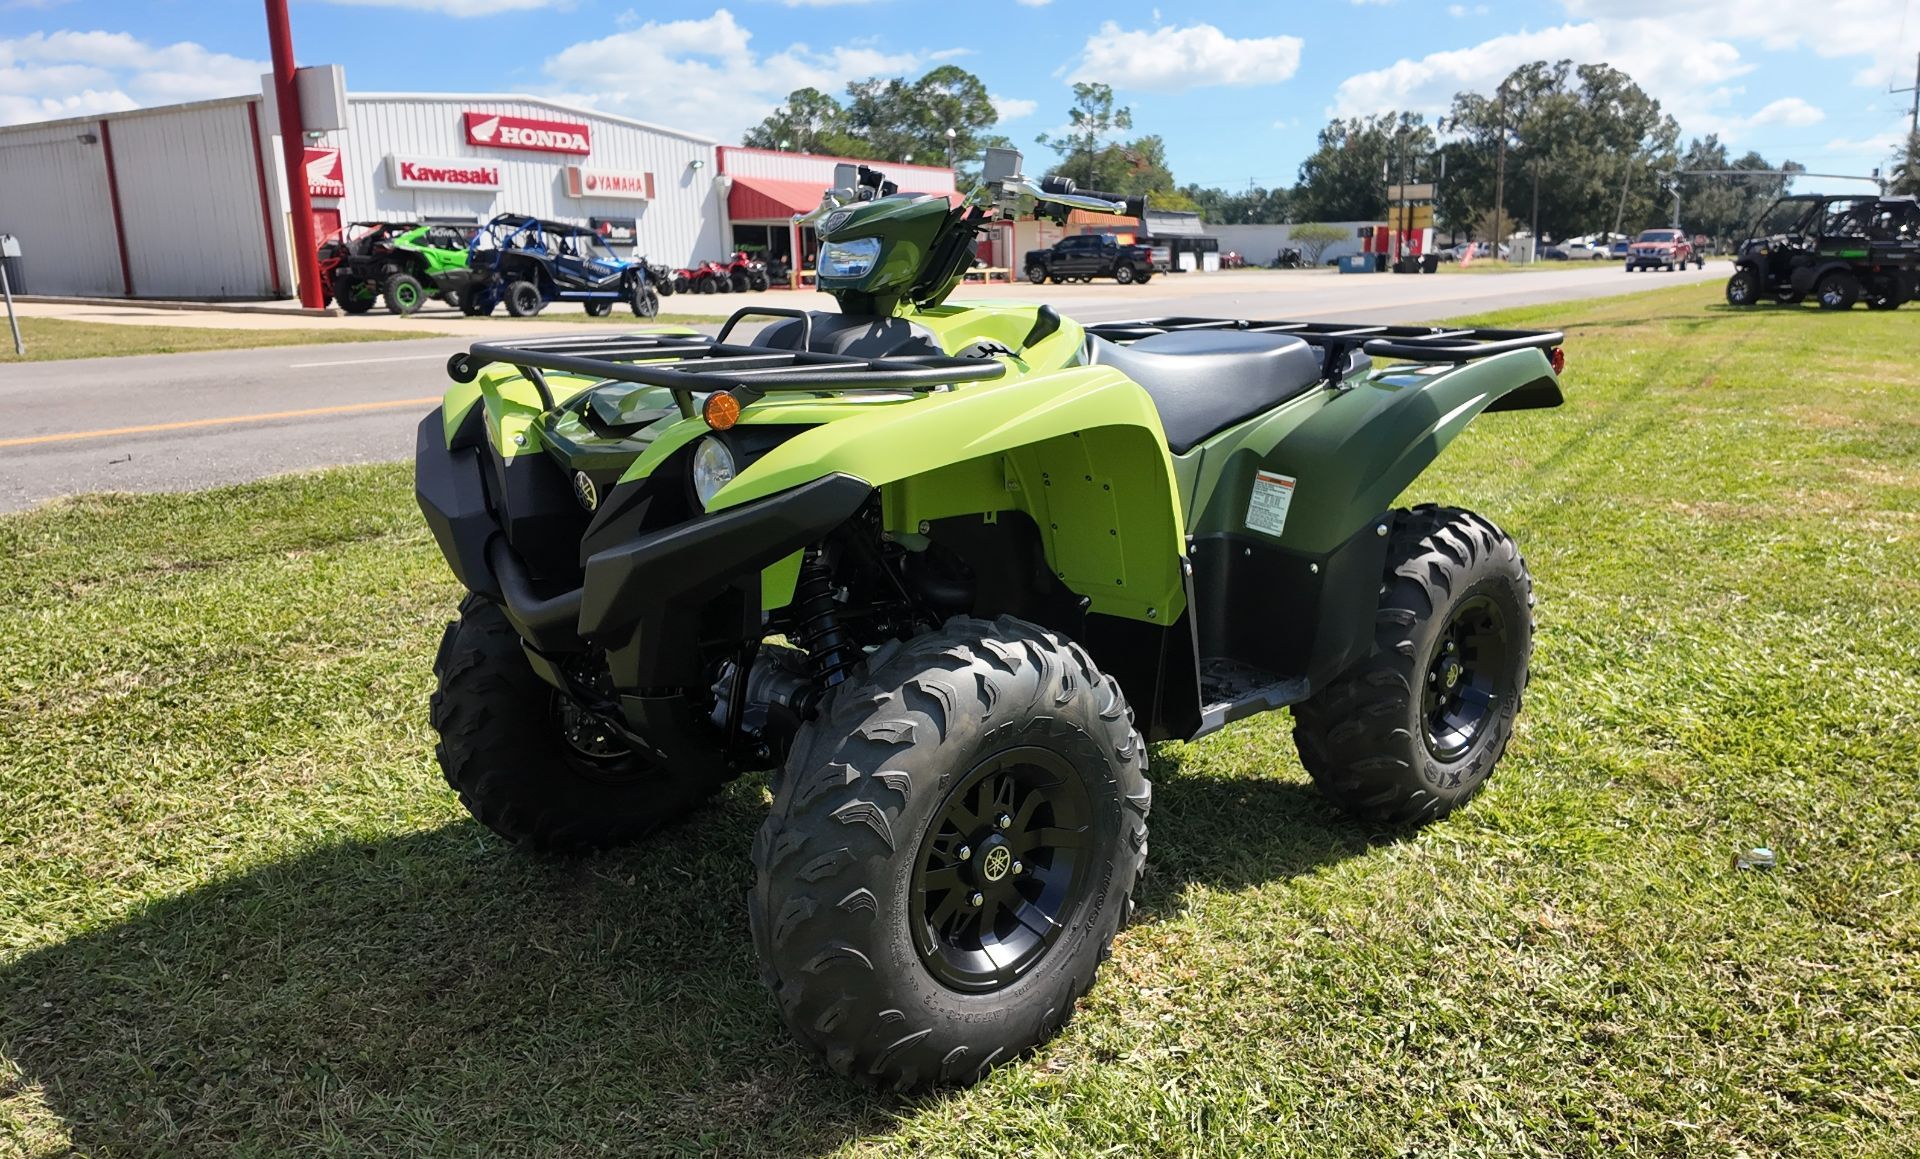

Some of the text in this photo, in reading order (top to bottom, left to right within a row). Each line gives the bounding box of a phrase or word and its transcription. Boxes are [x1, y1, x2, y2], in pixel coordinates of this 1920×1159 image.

[499, 127, 589, 150] HONDA
[401, 162, 498, 185] Kawasaki
[599, 176, 642, 192] YAMAHA
